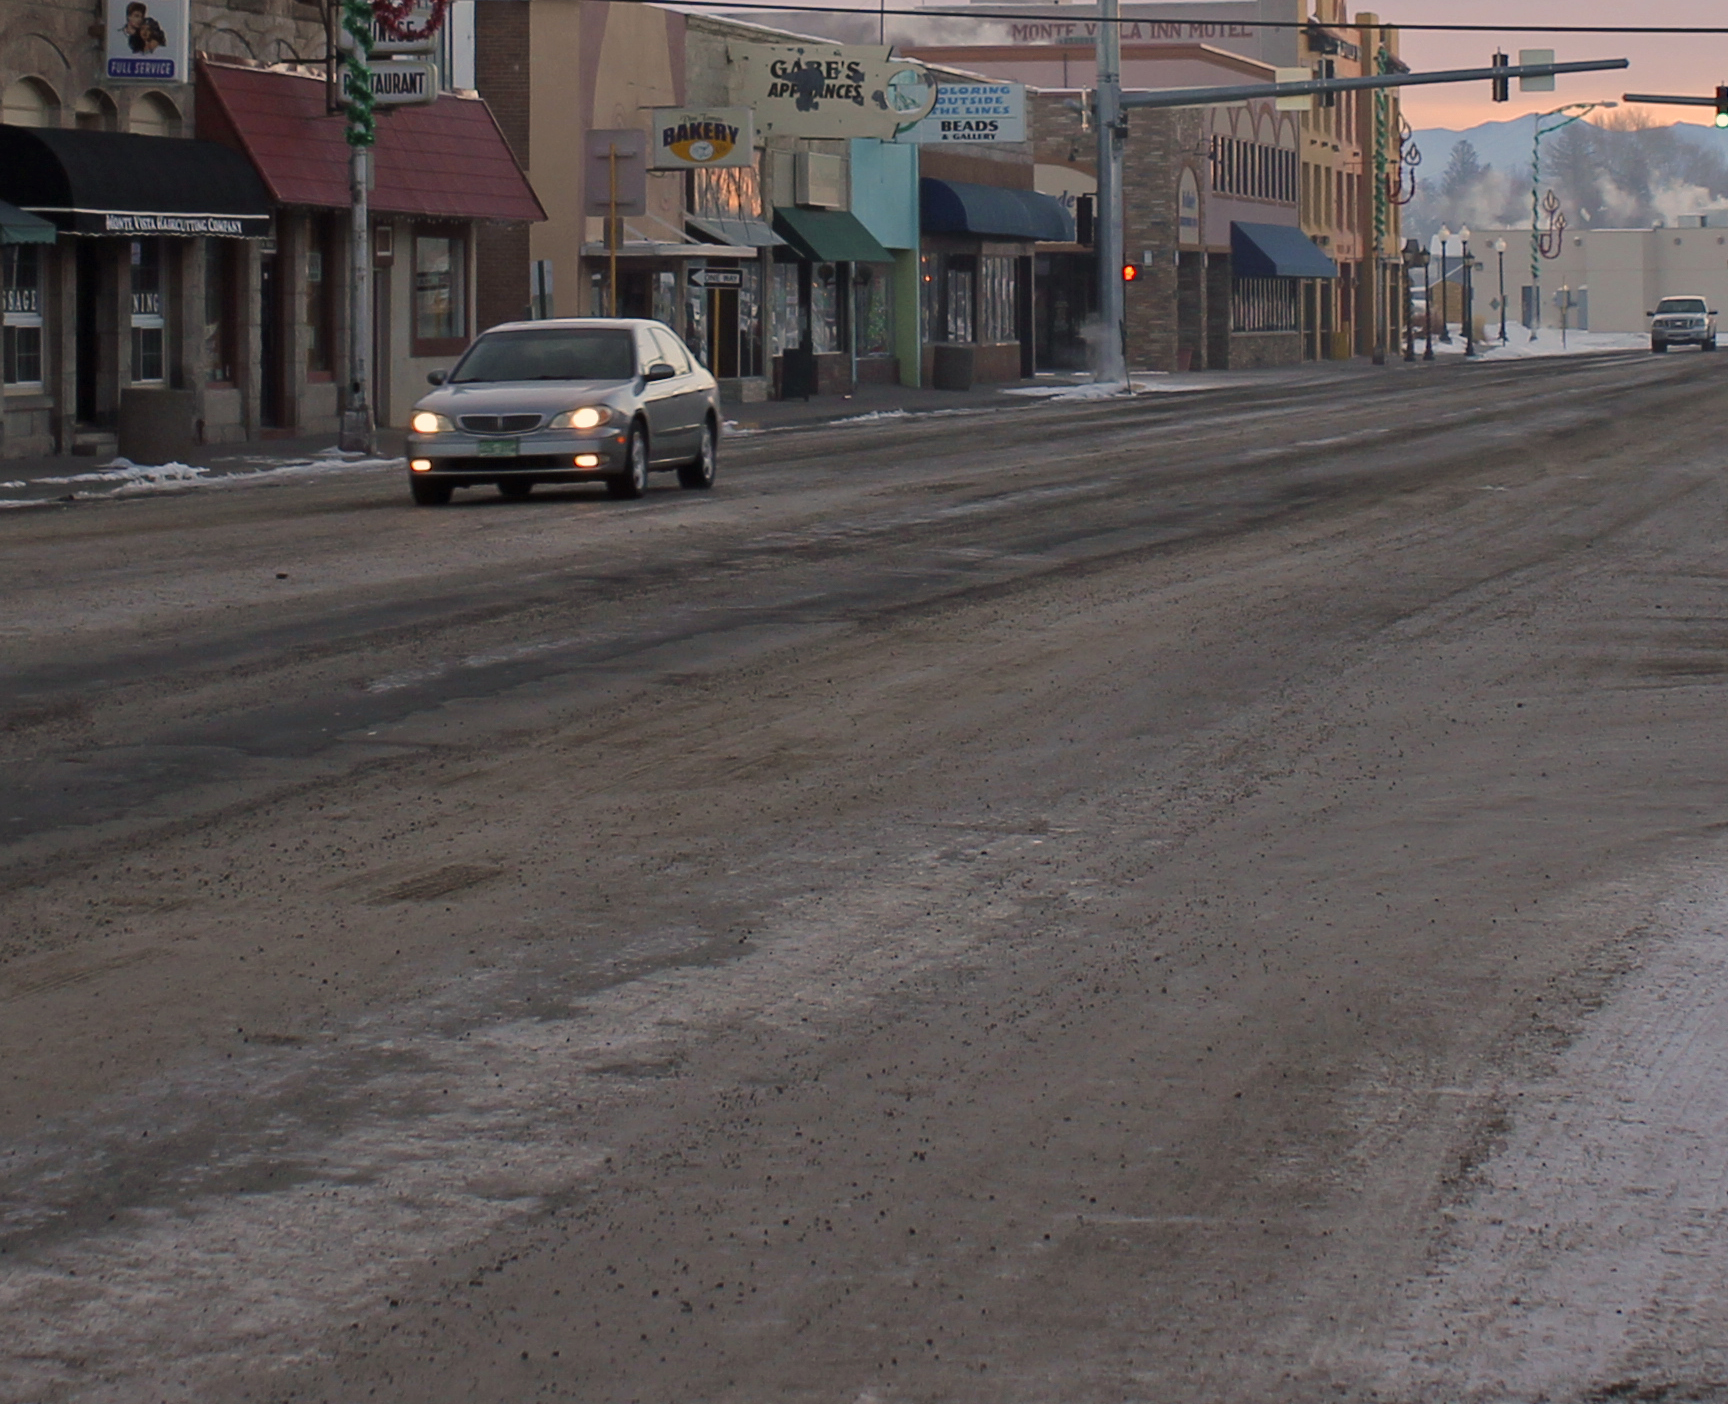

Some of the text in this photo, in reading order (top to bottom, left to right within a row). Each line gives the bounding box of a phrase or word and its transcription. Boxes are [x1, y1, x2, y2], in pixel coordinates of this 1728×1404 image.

[1084, 23, 1142, 40] VLA
[1150, 22, 1182, 39] INN
[1188, 23, 1254, 39] MOTEL
[111, 61, 172, 75] FULL SERVICE
[344, 72, 426, 95] RTAURANT
[767, 82, 863, 99] APPNCES
[938, 86, 1010, 95] OLORING
[965, 106, 1010, 114] LINES
[941, 120, 999, 132] BEADS
[663, 121, 740, 147] BAKERY
